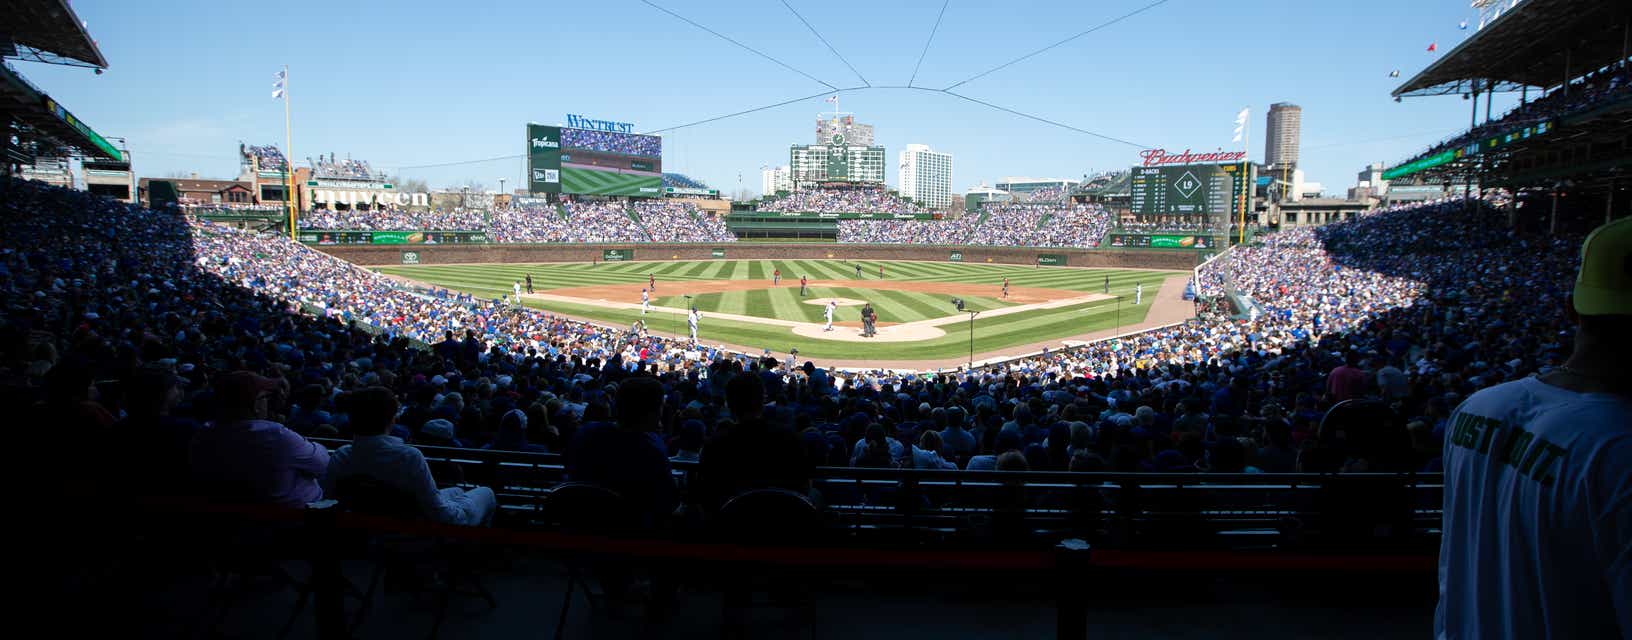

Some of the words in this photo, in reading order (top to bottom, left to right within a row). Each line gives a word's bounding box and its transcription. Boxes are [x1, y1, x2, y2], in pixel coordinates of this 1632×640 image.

[566, 113, 635, 133] WINTRUST
[1139, 148, 1246, 167] Budweiser
[1451, 412, 1502, 454] UST
